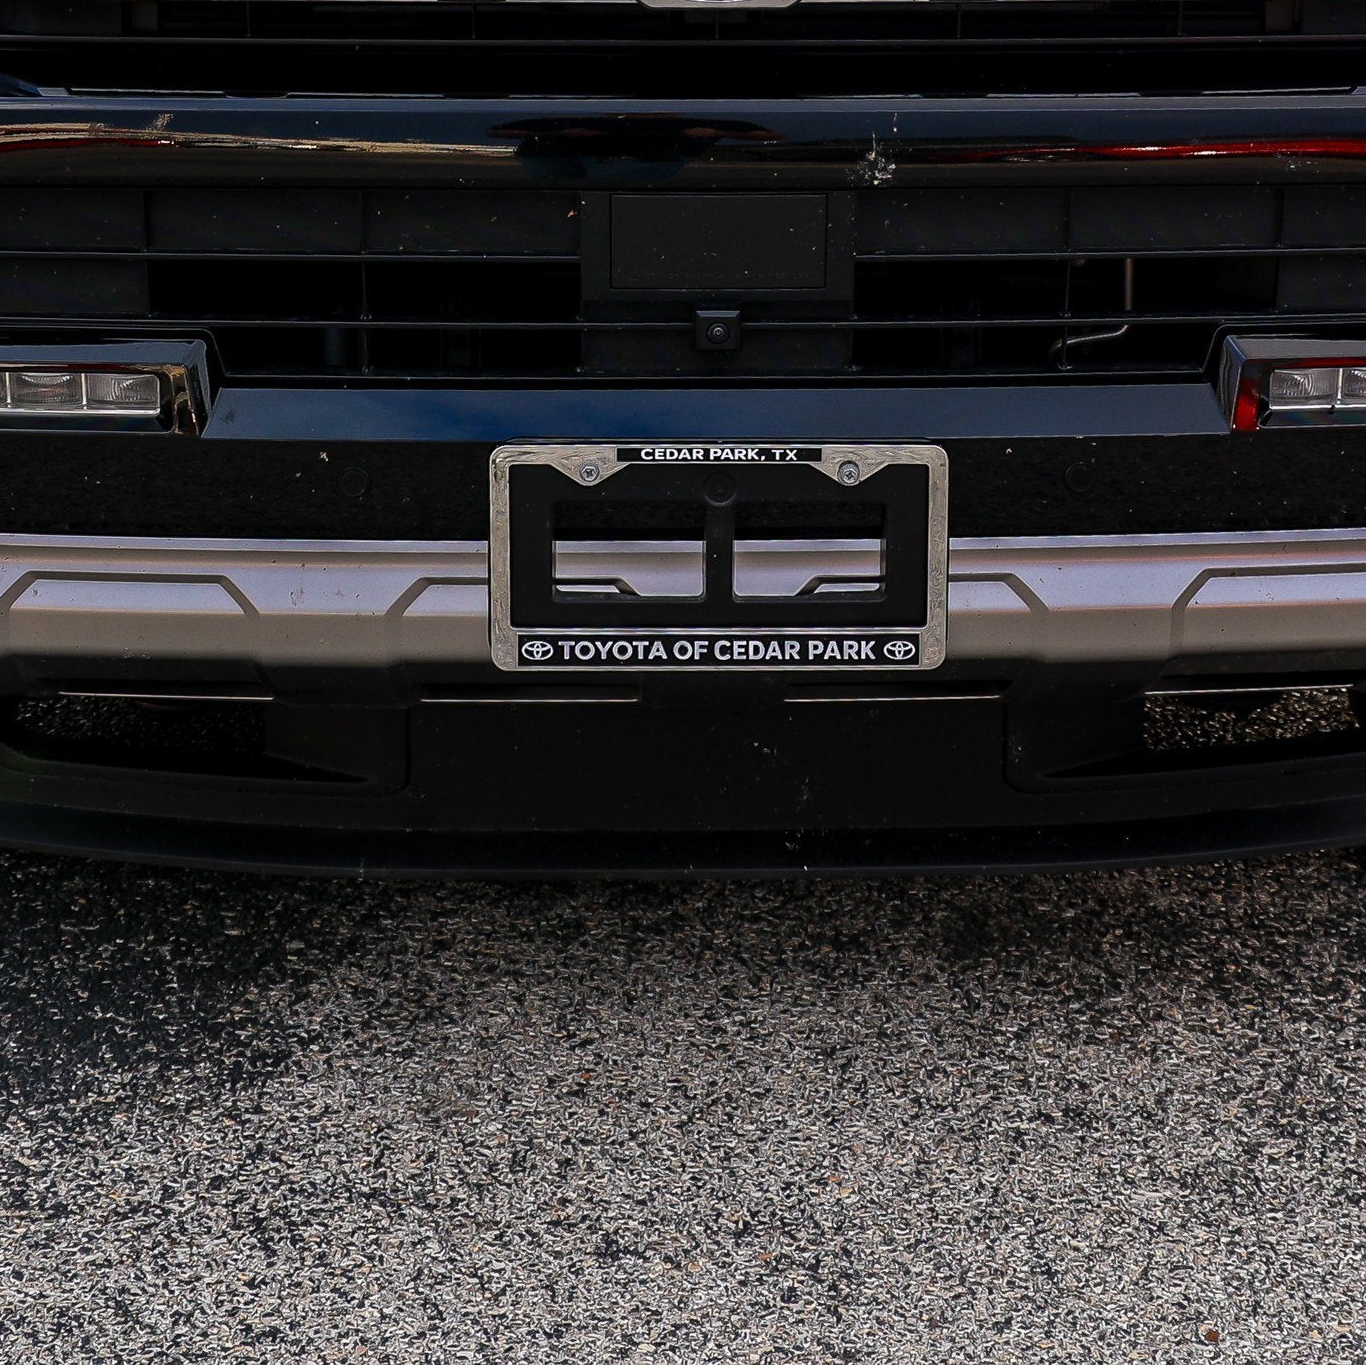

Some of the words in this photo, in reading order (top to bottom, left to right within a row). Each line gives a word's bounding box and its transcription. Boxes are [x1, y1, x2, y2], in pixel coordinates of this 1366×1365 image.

[640, 447, 704, 461] CEDAR
[709, 447, 766, 462] PARK,
[771, 449, 798, 461] TX
[557, 640, 668, 660] TOYOTA
[673, 640, 708, 660] OF
[714, 639, 801, 661] CEDAR
[808, 640, 876, 660] PARK
